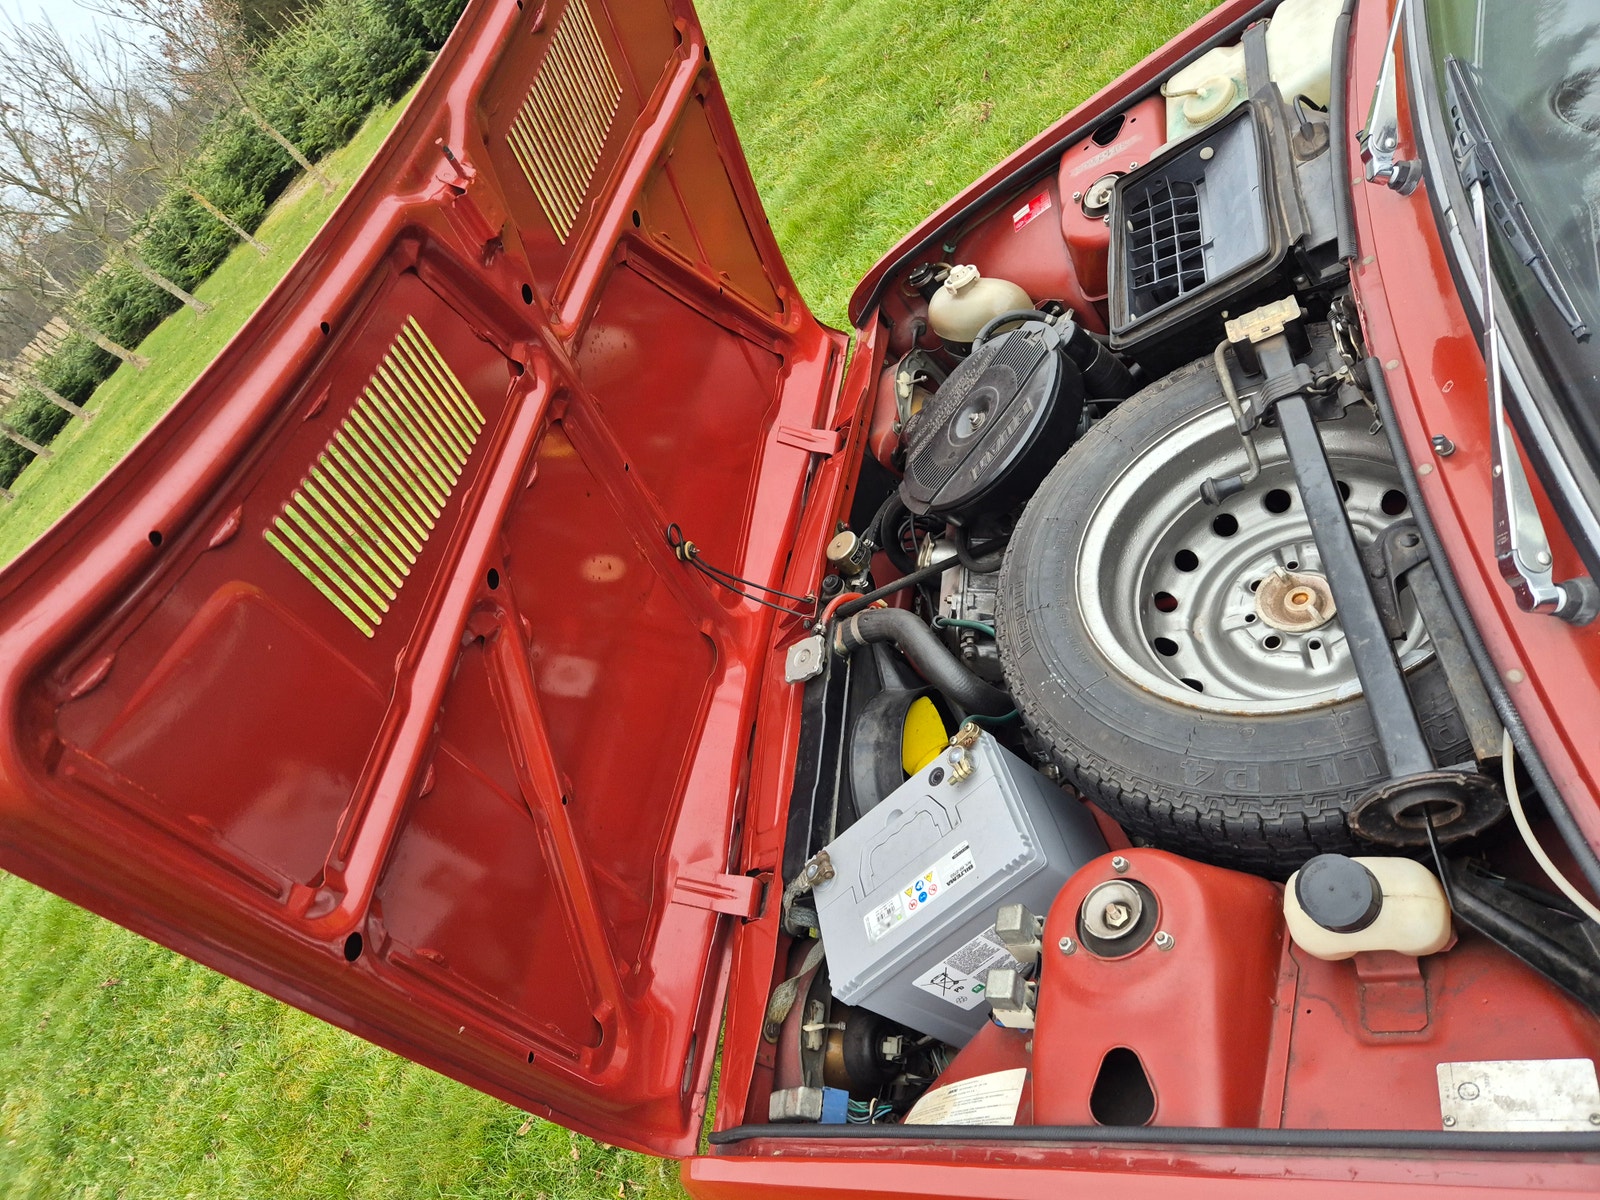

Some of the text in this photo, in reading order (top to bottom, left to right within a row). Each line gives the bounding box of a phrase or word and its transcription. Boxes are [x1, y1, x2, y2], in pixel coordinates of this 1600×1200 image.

[969, 397, 1034, 483] FIAT
[946, 864, 974, 887] BILTEMA
[954, 985, 965, 993] Pb
